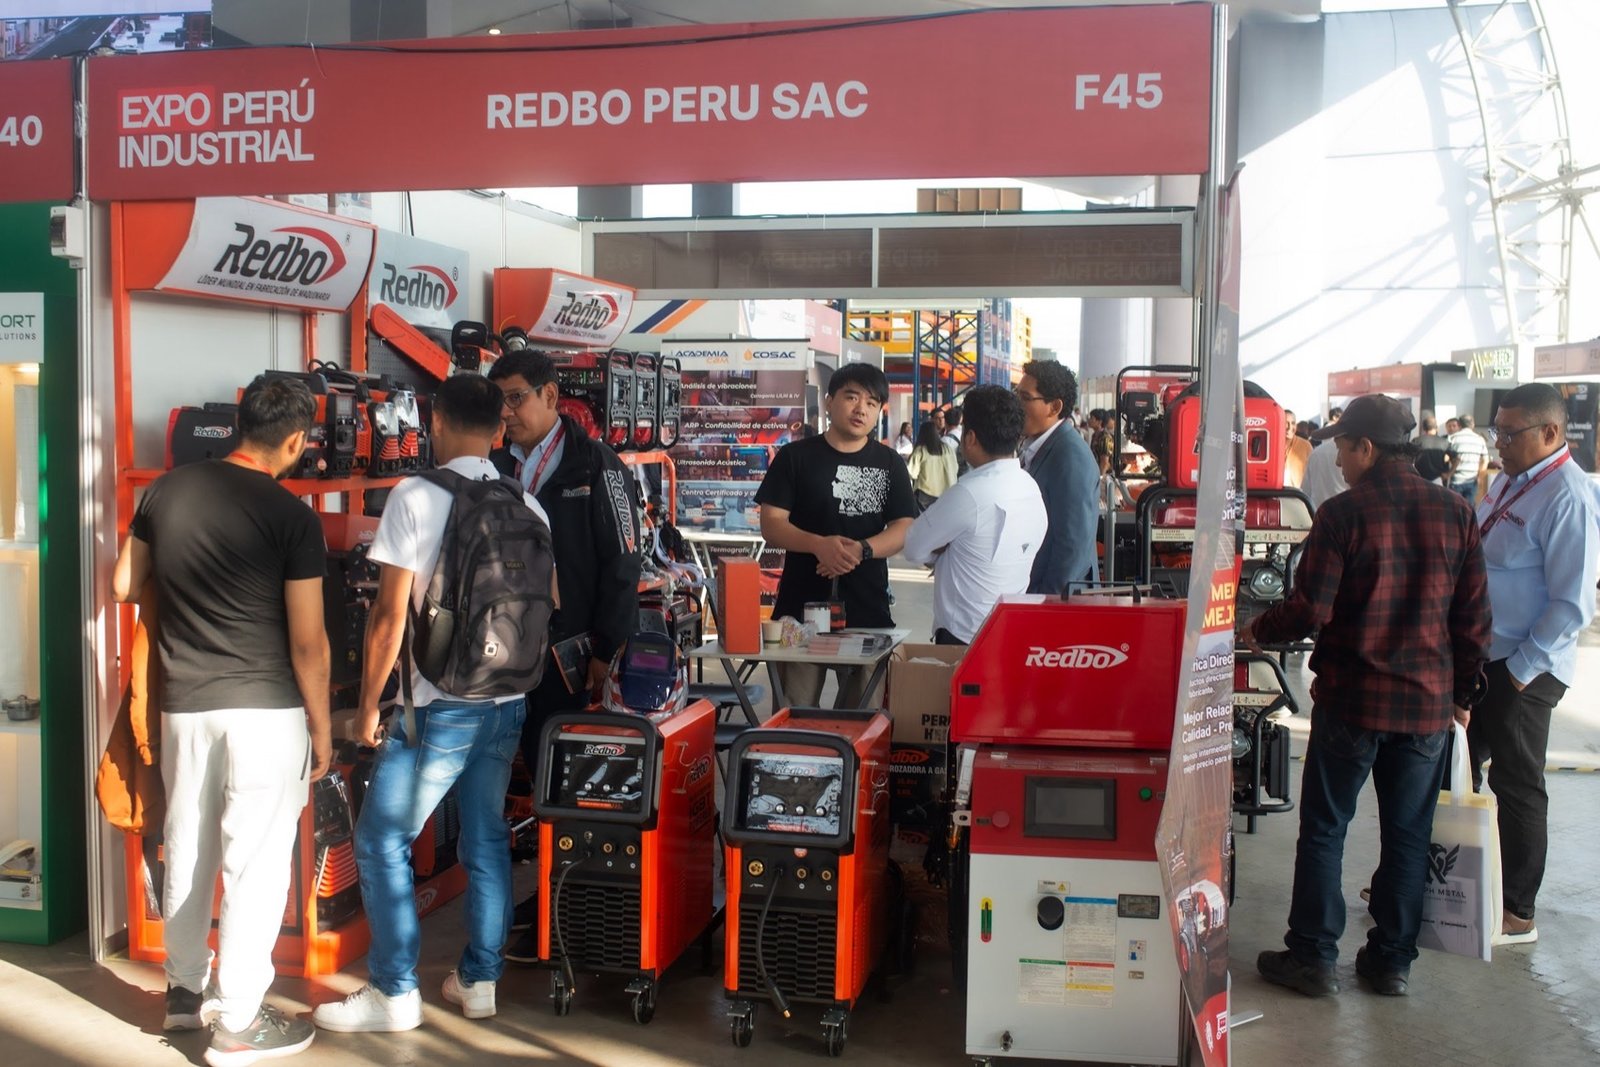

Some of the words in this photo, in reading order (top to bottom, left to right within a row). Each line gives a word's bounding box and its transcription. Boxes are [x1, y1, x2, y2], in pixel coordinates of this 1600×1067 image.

[1075, 72, 1163, 110] F45
[122, 92, 211, 129] EXPO
[222, 78, 314, 124] PERÚ
[487, 89, 631, 129] REDBO
[644, 84, 759, 123] PERU
[772, 81, 868, 119] SAC
[118, 129, 314, 168] INDUSTRIAL
[213, 222, 328, 286] Redbo
[217, 277, 245, 290] MUNDIAL
[245, 281, 255, 291] EN
[290, 287, 298, 297] DE
[380, 262, 445, 311] Redbo
[553, 291, 611, 330] Redbo
[753, 351, 796, 359] COSAC
[717, 382, 757, 390] vibraciones
[705, 422, 751, 430] Confiabilidad
[763, 421, 787, 430] activos
[716, 459, 747, 467] Acústico
[681, 488, 704, 496] Centro
[705, 488, 743, 496] Certificado
[606, 468, 634, 543] Redbo
[1025, 644, 1113, 669] Redbo
[1183, 710, 1204, 726] Mejor
[1182, 724, 1211, 743] Calidad
[585, 743, 618, 755] Redbo
[927, 766, 934, 774] A
[1438, 889, 1466, 897] METAL
